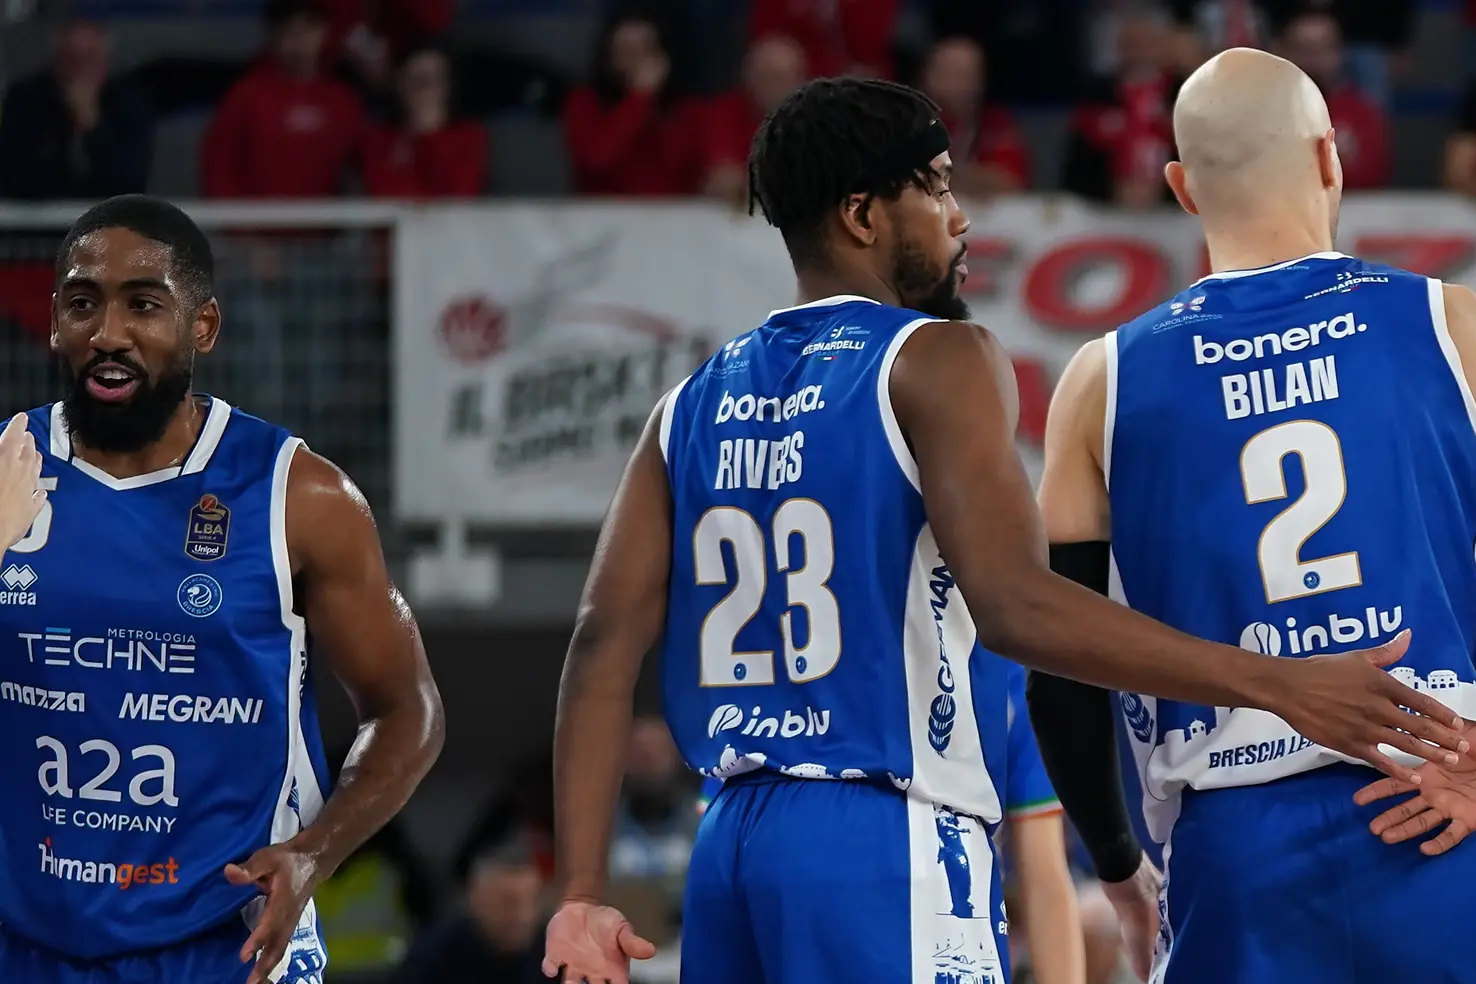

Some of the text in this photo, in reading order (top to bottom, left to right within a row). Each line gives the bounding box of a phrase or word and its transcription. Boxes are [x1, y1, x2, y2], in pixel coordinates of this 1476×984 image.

[1221, 355, 1340, 419] BILAN
[715, 431, 804, 490] RIVERS
[1239, 419, 1362, 604] 2
[194, 522, 224, 535] LBA
[194, 544, 219, 555] Unipol
[182, 600, 214, 614] BRESCIA
[693, 497, 842, 688] 23
[108, 627, 196, 643] METROLOGIA
[1286, 606, 1403, 654] inblu
[18, 627, 196, 673] TECHNE
[1, 681, 85, 712] mazza
[118, 692, 264, 724] MEGRANI
[742, 705, 831, 738] inblu
[1208, 737, 1285, 769] BRESCIA
[36, 735, 179, 807] a2a
[42, 803, 177, 833] LFE COMPANY
